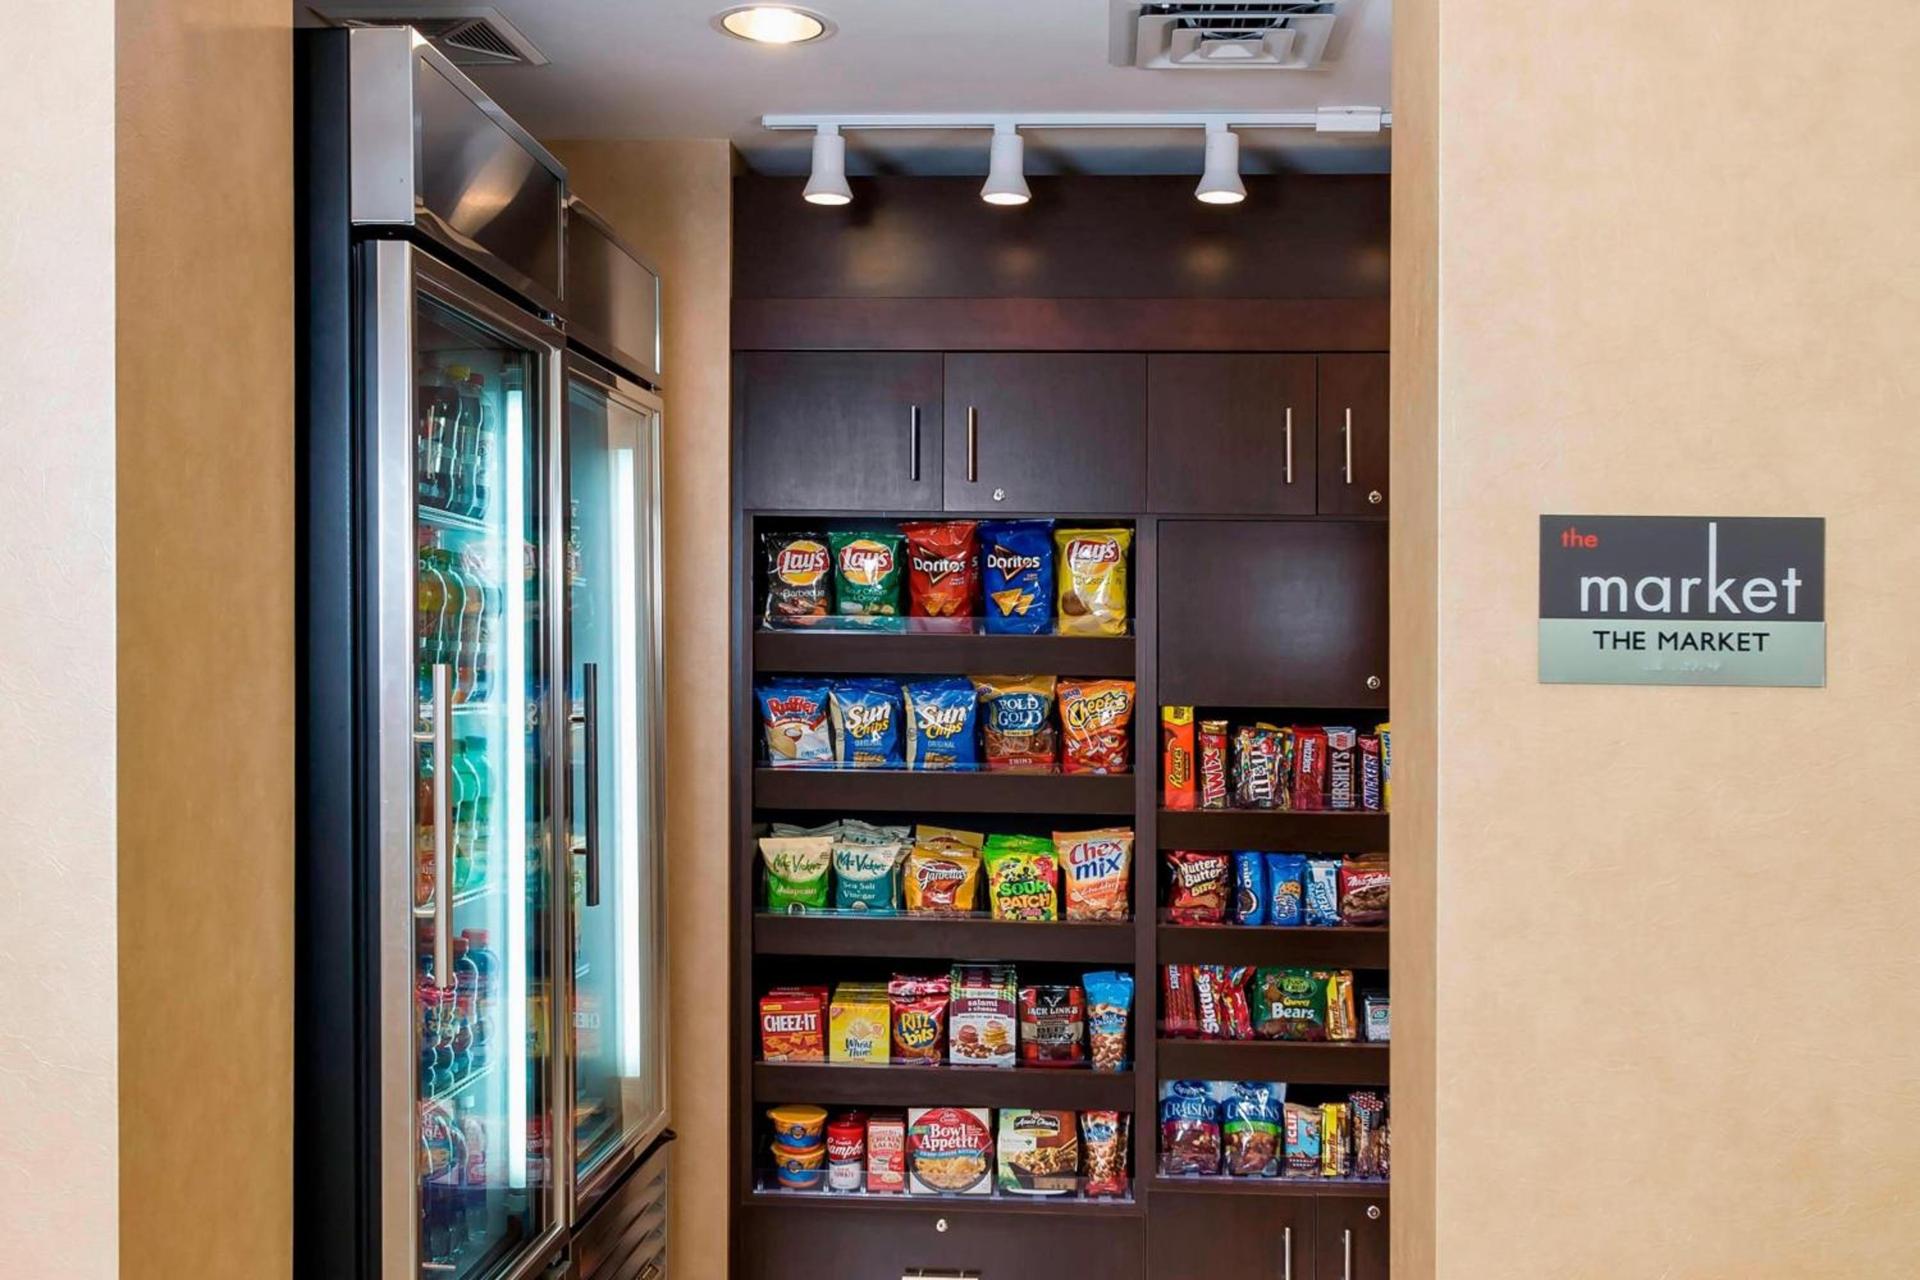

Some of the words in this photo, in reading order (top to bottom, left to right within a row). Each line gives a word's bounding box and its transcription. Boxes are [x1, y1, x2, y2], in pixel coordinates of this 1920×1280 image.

[1561, 528, 1598, 548] the
[842, 547, 889, 571] Lay's
[1071, 540, 1116, 562] Lay's
[782, 551, 824, 573] Lay's
[913, 557, 965, 572] Doritos
[987, 554, 1040, 568] Doritos
[1580, 522, 1802, 614] market
[1592, 631, 1645, 650] THE
[1658, 632, 1770, 652] MARKET
[999, 697, 1039, 710] ROLD
[1069, 692, 1126, 727] Cheetos
[847, 701, 891, 729] Sun
[919, 704, 967, 729] Sun
[999, 710, 1042, 726] GOLD
[853, 719, 889, 738] Chips
[926, 722, 962, 738] Chips
[1332, 752, 1351, 808] HERSHEY'S
[1069, 840, 1122, 865] Chex
[1180, 859, 1217, 874] Nutter
[1185, 868, 1222, 887] Butter
[1000, 881, 1048, 896] SOUR
[1000, 894, 1050, 908] PATCH
[1272, 1002, 1315, 1019] Bears
[764, 1013, 817, 1032] CHEEZ-IT
[901, 1012, 932, 1032] RITZ
[931, 1123, 966, 1138] Bowl
